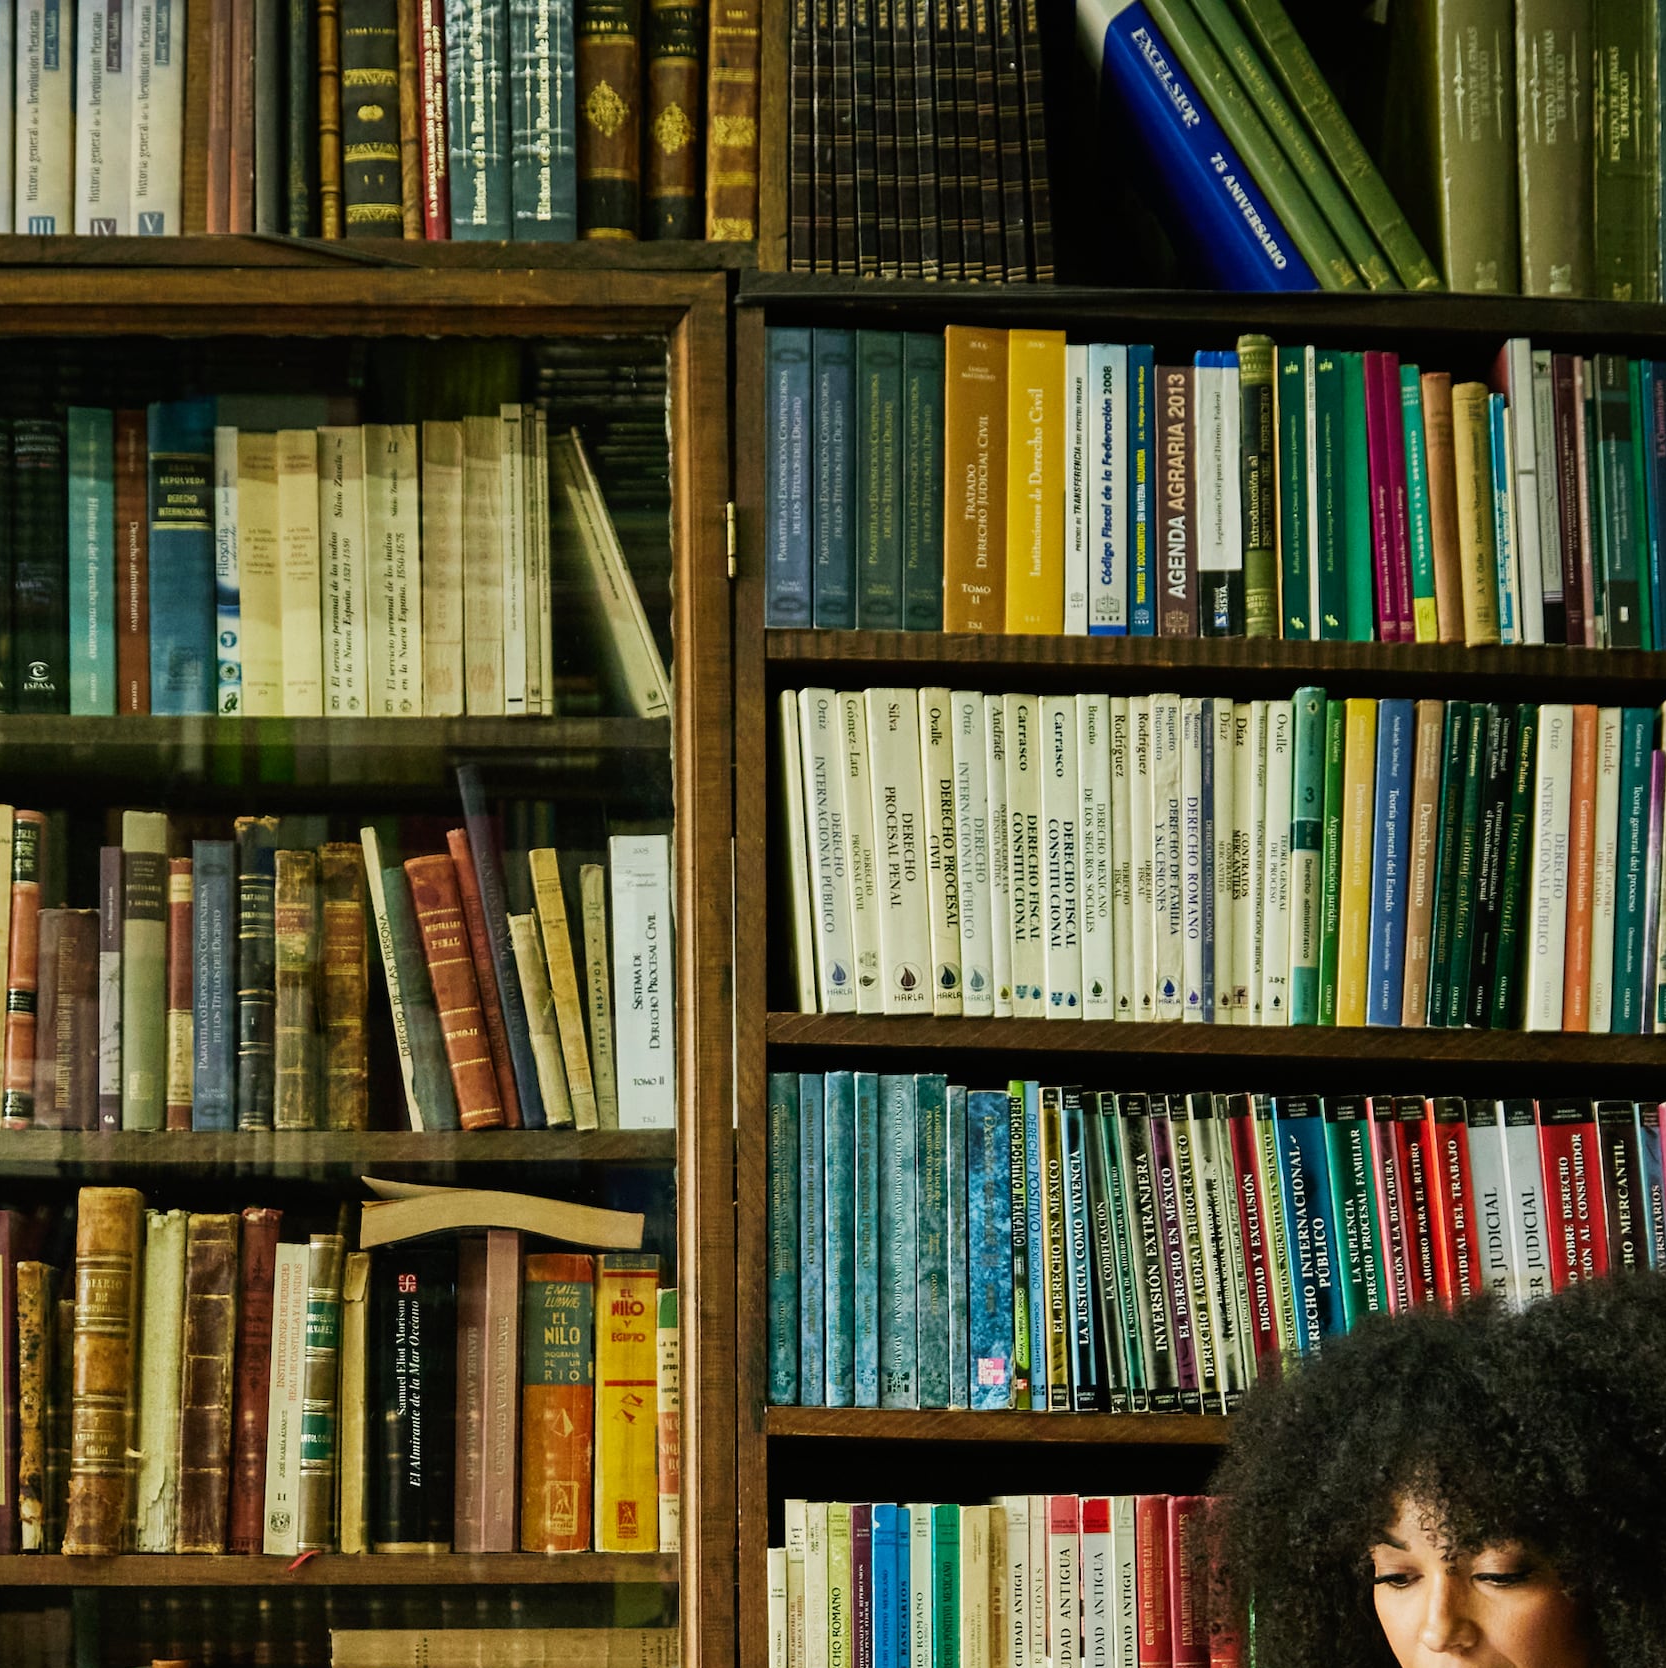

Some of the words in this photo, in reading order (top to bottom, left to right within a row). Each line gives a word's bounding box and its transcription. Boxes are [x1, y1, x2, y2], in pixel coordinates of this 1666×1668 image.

[1131, 27, 1200, 128] EXCELSIOR
[1210, 153, 1228, 173] 75
[1223, 175, 1286, 269] ANIVERSARIO
[1103, 365, 1112, 394] 2008
[1168, 373, 1184, 418] 2013
[1028, 388, 1043, 423] Civil
[977, 415, 988, 447] CIVIL
[1101, 398, 1113, 466] Federación
[977, 449, 989, 505] JUDICIAL
[1028, 427, 1043, 485] Derecho
[1101, 469, 1112, 482] la
[1168, 423, 1184, 511] AGRARIA
[965, 464, 976, 520] TRATADO
[1031, 488, 1042, 502] de
[1102, 486, 1112, 500] de
[977, 507, 988, 568] DERECHO
[1030, 505, 1042, 576] Instituciones
[1102, 504, 1113, 538] Fiscal
[1102, 542, 1114, 585] Código
[1169, 515, 1186, 598] AGENDA
[961, 583, 991, 593] TOMO
[888, 703, 900, 731] Silva
[1054, 712, 1065, 777] Carrasco
[884, 786, 897, 858] PROCESAL
[1388, 789, 1399, 818] Teoría
[902, 813, 915, 881] DERECHO
[1187, 797, 1198, 866] DERECHO
[1327, 816, 1339, 891] Argumentación
[1386, 821, 1397, 857] general
[1063, 822, 1074, 894] DERECHO
[1386, 860, 1395, 875] del
[889, 864, 900, 909] PENAL
[1049, 819, 1061, 950] CONSTITUCIONAL
[1188, 873, 1198, 939] ROMANO
[1385, 878, 1395, 911] Estado
[1065, 898, 1076, 948] FISCAL
[1326, 894, 1338, 931] jurídica
[1048, 1160, 1060, 1213] MÉXICO
[1572, 1134, 1589, 1219] CONSUMIDOR
[1615, 1140, 1631, 1234] MERCANTIL
[1136, 1153, 1158, 1256] EXTRANJERA
[1289, 1146, 1313, 1277] INTERNACIONAL
[1051, 1221, 1061, 1237] EN
[1522, 1186, 1545, 1269] JUDICIAL
[1580, 1225, 1589, 1241] AL
[1313, 1217, 1332, 1287] PÚBLICO
[545, 1284, 580, 1295] EMIL
[1051, 1245, 1062, 1309] DERECHO
[396, 1300, 406, 1344] Morison
[408, 1301, 420, 1346] Océano
[544, 1296, 580, 1308] LUDWIG
[552, 1312, 568, 1325] EL
[1053, 1316, 1063, 1332] EL
[1146, 1264, 1168, 1351] INVERSIÓN
[544, 1327, 580, 1344] NILO
[396, 1347, 406, 1372] Eliot
[410, 1350, 420, 1375] Mar
[397, 1376, 406, 1415] Samuel
[410, 1378, 420, 1390] la
[410, 1392, 420, 1407] de
[410, 1410, 421, 1470] Almirante
[411, 1473, 421, 1486] El
[1060, 1548, 1071, 1619] ANTIGUA
